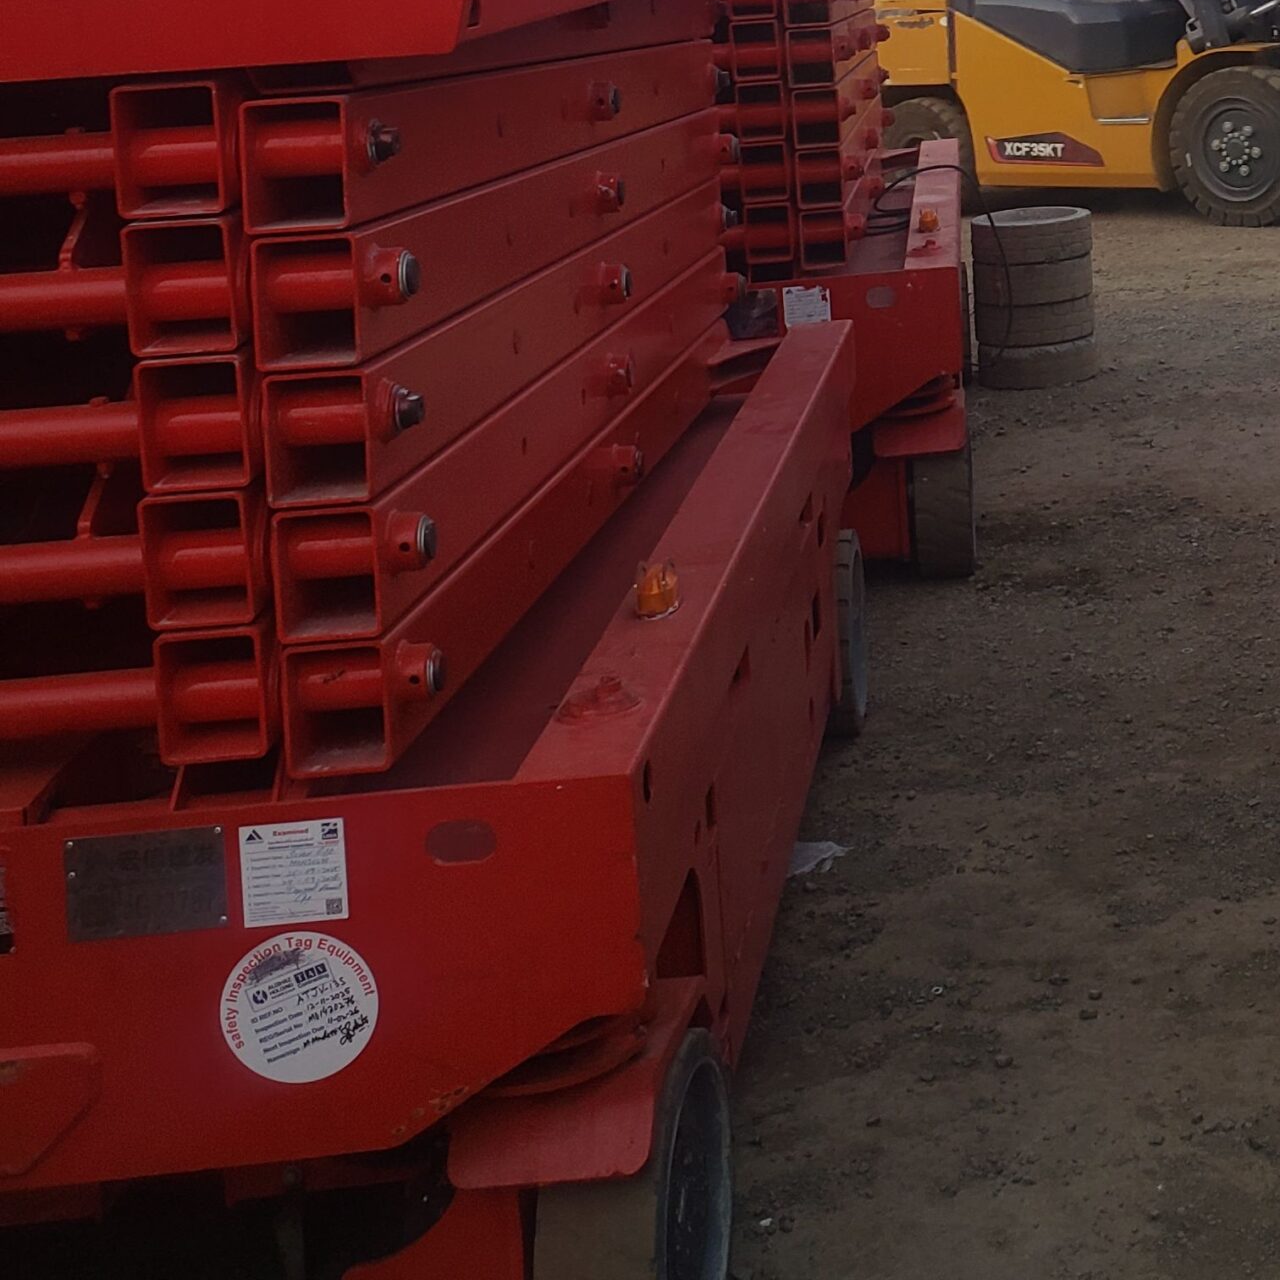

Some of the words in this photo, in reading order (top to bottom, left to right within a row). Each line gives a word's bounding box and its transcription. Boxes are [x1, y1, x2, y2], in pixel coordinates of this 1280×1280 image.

[285, 937, 313, 951] Tag
[317, 938, 375, 997] Equipment
[226, 942, 281, 1004] Inspection
[226, 1008, 245, 1049] safety
